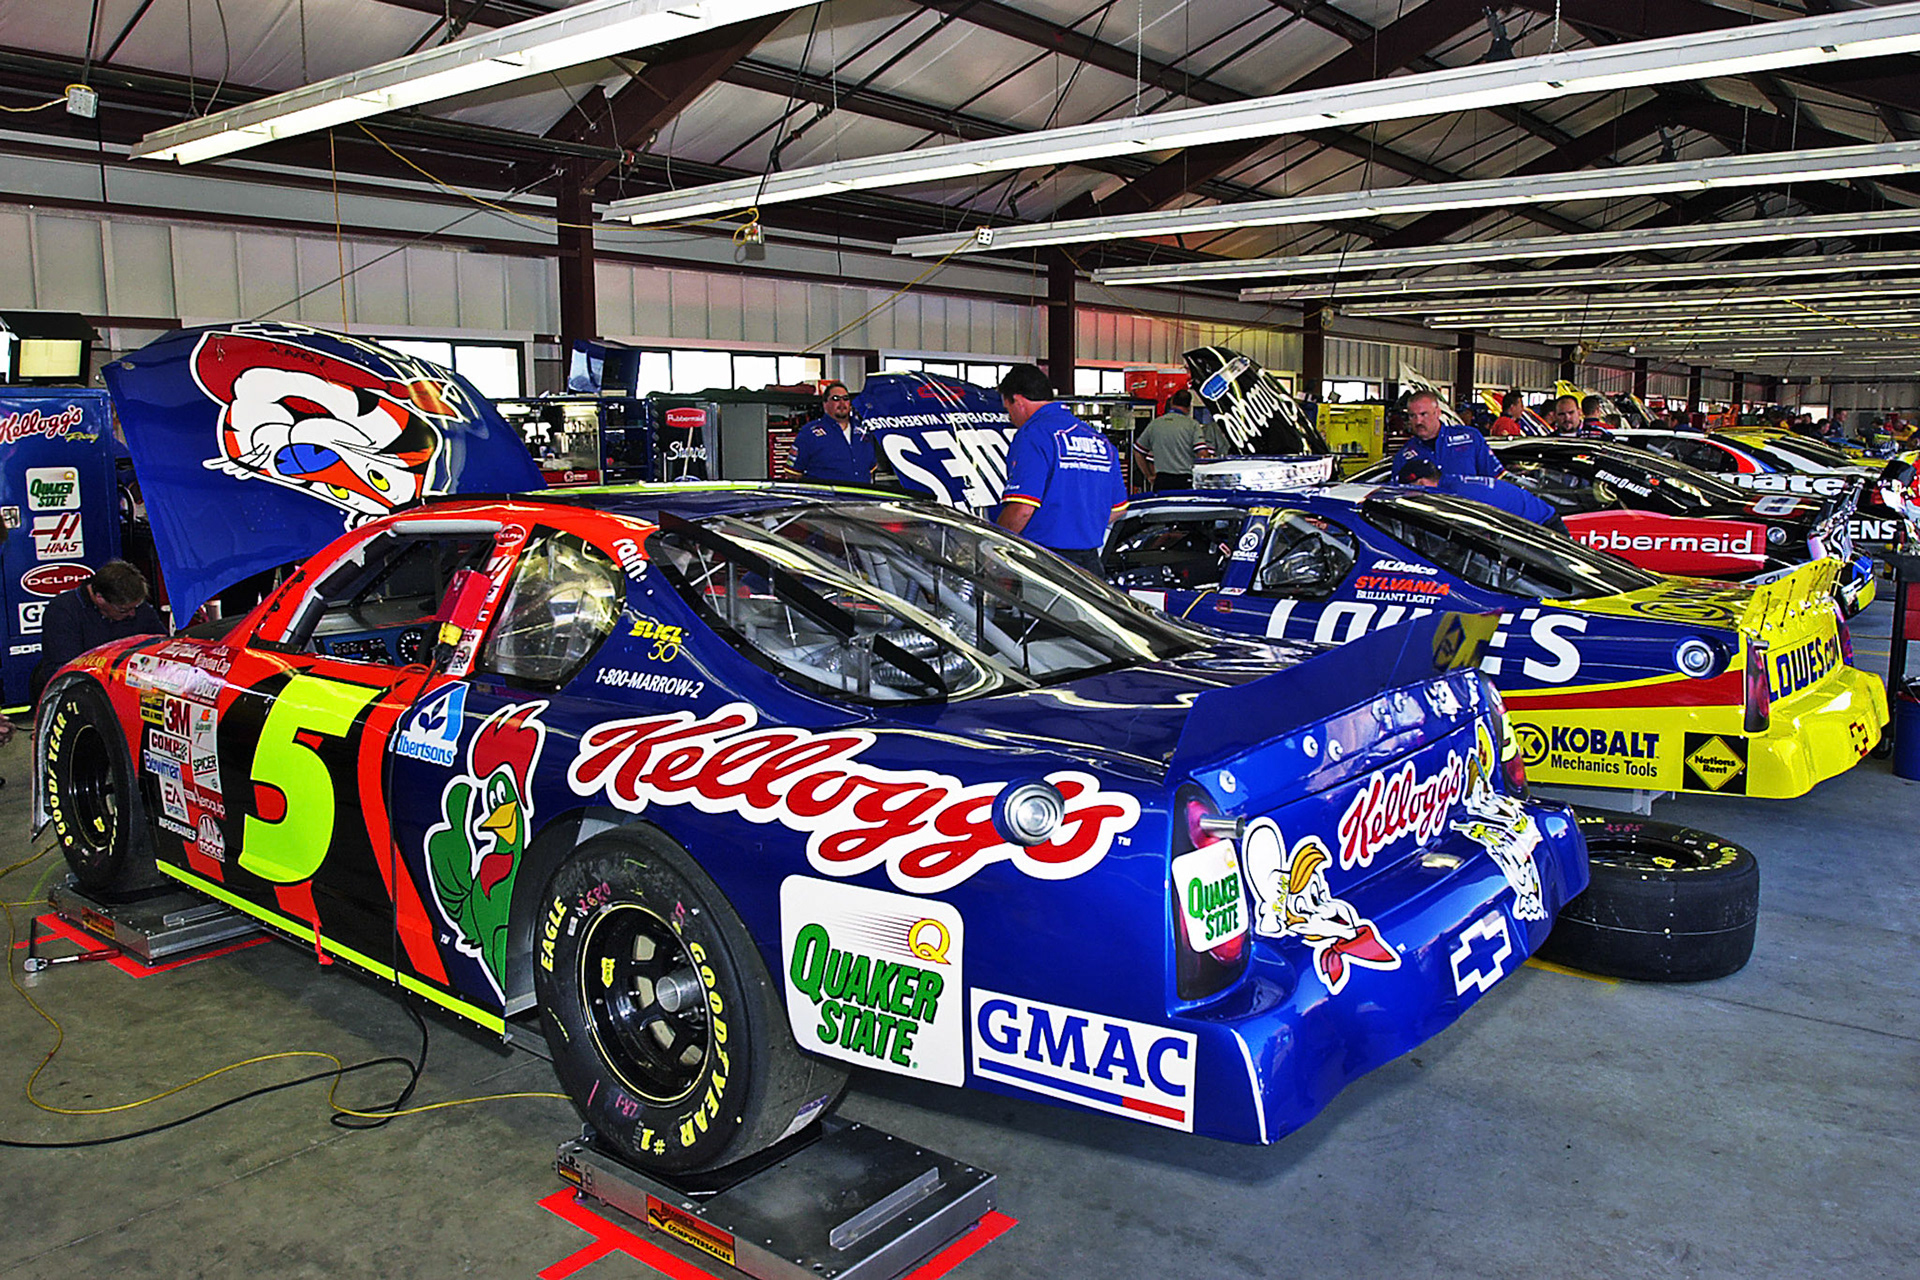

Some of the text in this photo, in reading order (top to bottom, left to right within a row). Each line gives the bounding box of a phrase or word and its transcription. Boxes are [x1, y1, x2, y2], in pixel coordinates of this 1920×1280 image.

[0, 404, 83, 444] Kellogg's
[1061, 433, 1107, 455] LOWE'S
[30, 479, 73, 497] QUAKER
[38, 496, 67, 508] STATE
[1372, 560, 1438, 575] ACDelco
[1354, 576, 1450, 596] SYLVANIA
[1356, 590, 1434, 605] BRILLIANT LIGHT
[648, 641, 678, 662] 50
[596, 668, 704, 698] 1-800-MARROW-2
[165, 699, 191, 737] 3M
[1552, 726, 1660, 759] KOBALT
[1551, 754, 1657, 777] Mechanics Tools
[1695, 755, 1736, 767] Nations
[1703, 764, 1727, 774] Rent
[238, 674, 385, 883] 5
[569, 705, 1138, 891] Kellogg's
[1339, 752, 1461, 868] Kellogg's
[1188, 872, 1240, 921] QUAKER
[541, 896, 568, 973] EAGLE
[1205, 902, 1239, 941] STATE
[790, 923, 944, 1024] QUAKER
[817, 1001, 920, 1068] STATE
[977, 999, 1189, 1098] GMAC
[640, 1128, 666, 1155] #1
